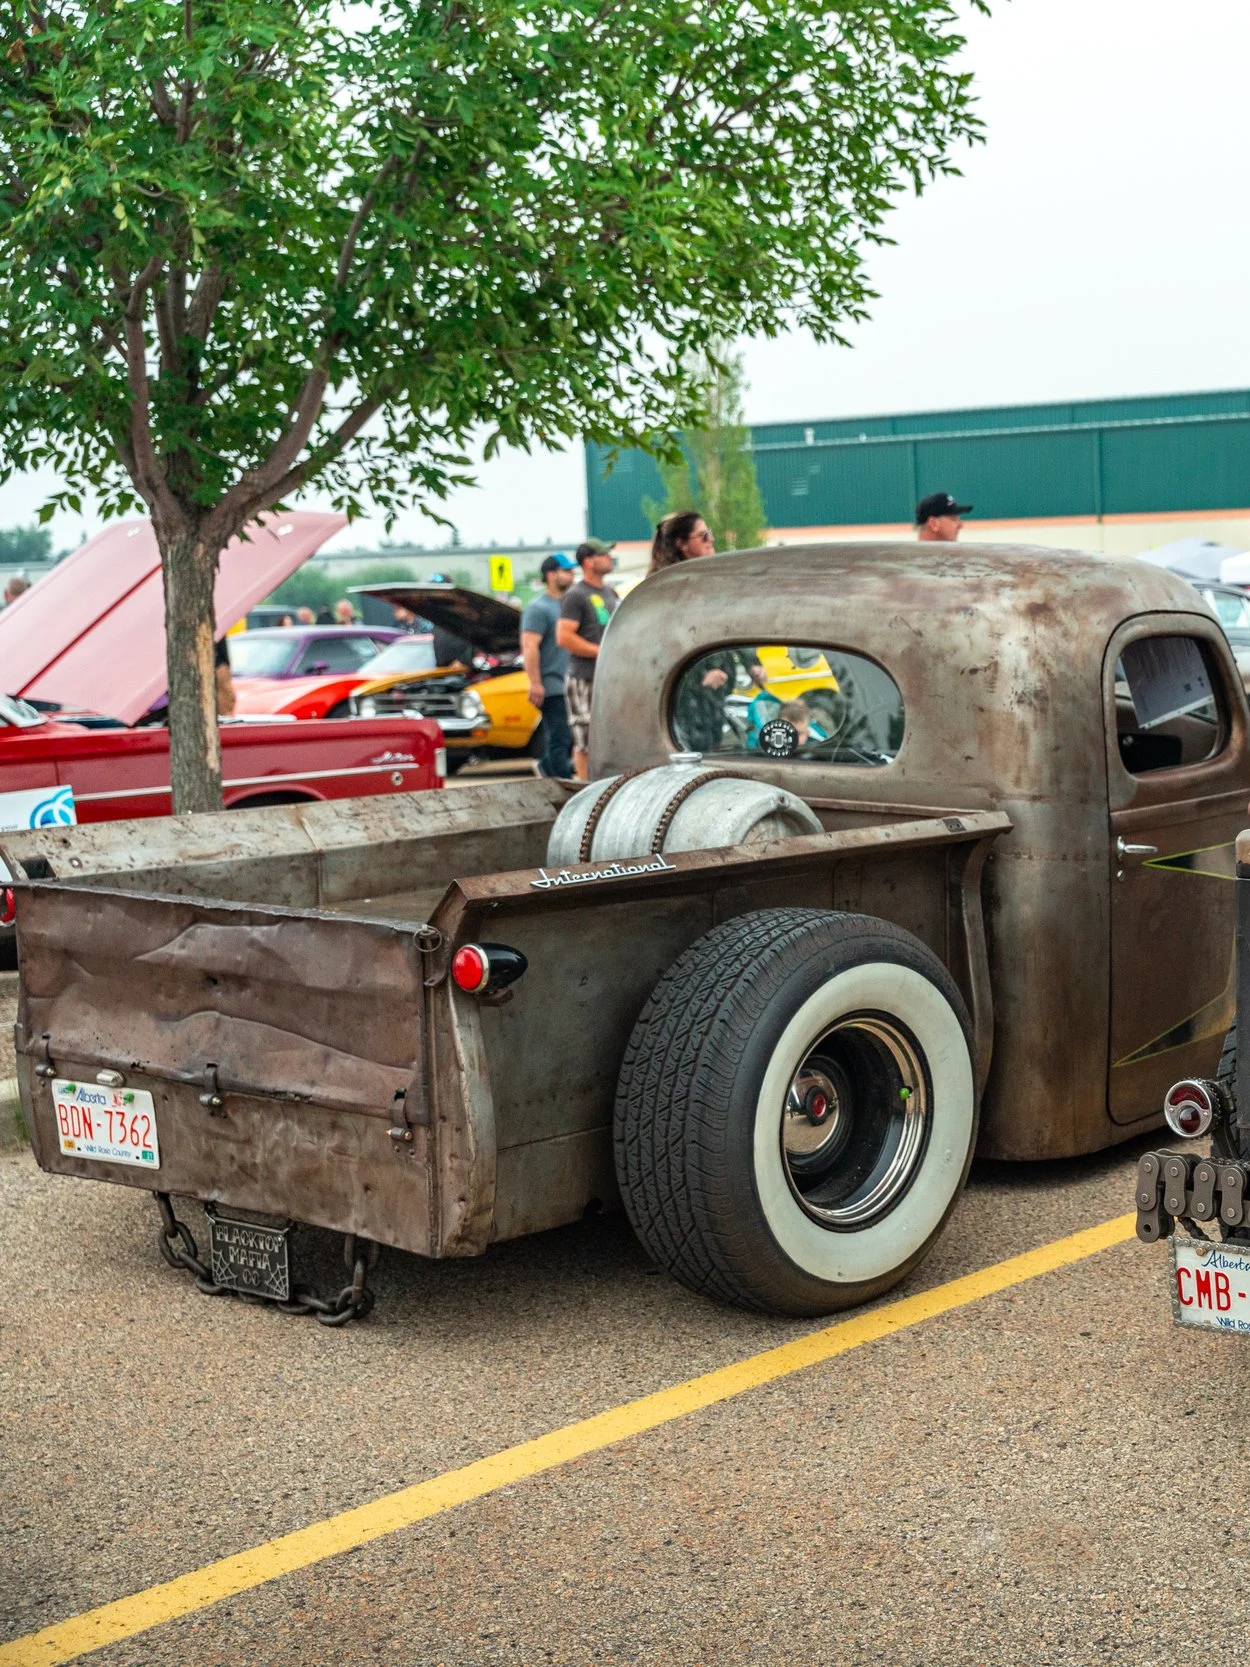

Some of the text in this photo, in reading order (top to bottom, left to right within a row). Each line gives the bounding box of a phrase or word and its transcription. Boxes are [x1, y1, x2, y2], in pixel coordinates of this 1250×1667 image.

[530, 853, 677, 889] International
[58, 1103, 152, 1149] BDN-7362
[215, 1224, 284, 1254] BLACKTOP
[228, 1245, 271, 1272] MAFIA
[1216, 1316, 1236, 1328] Wild
